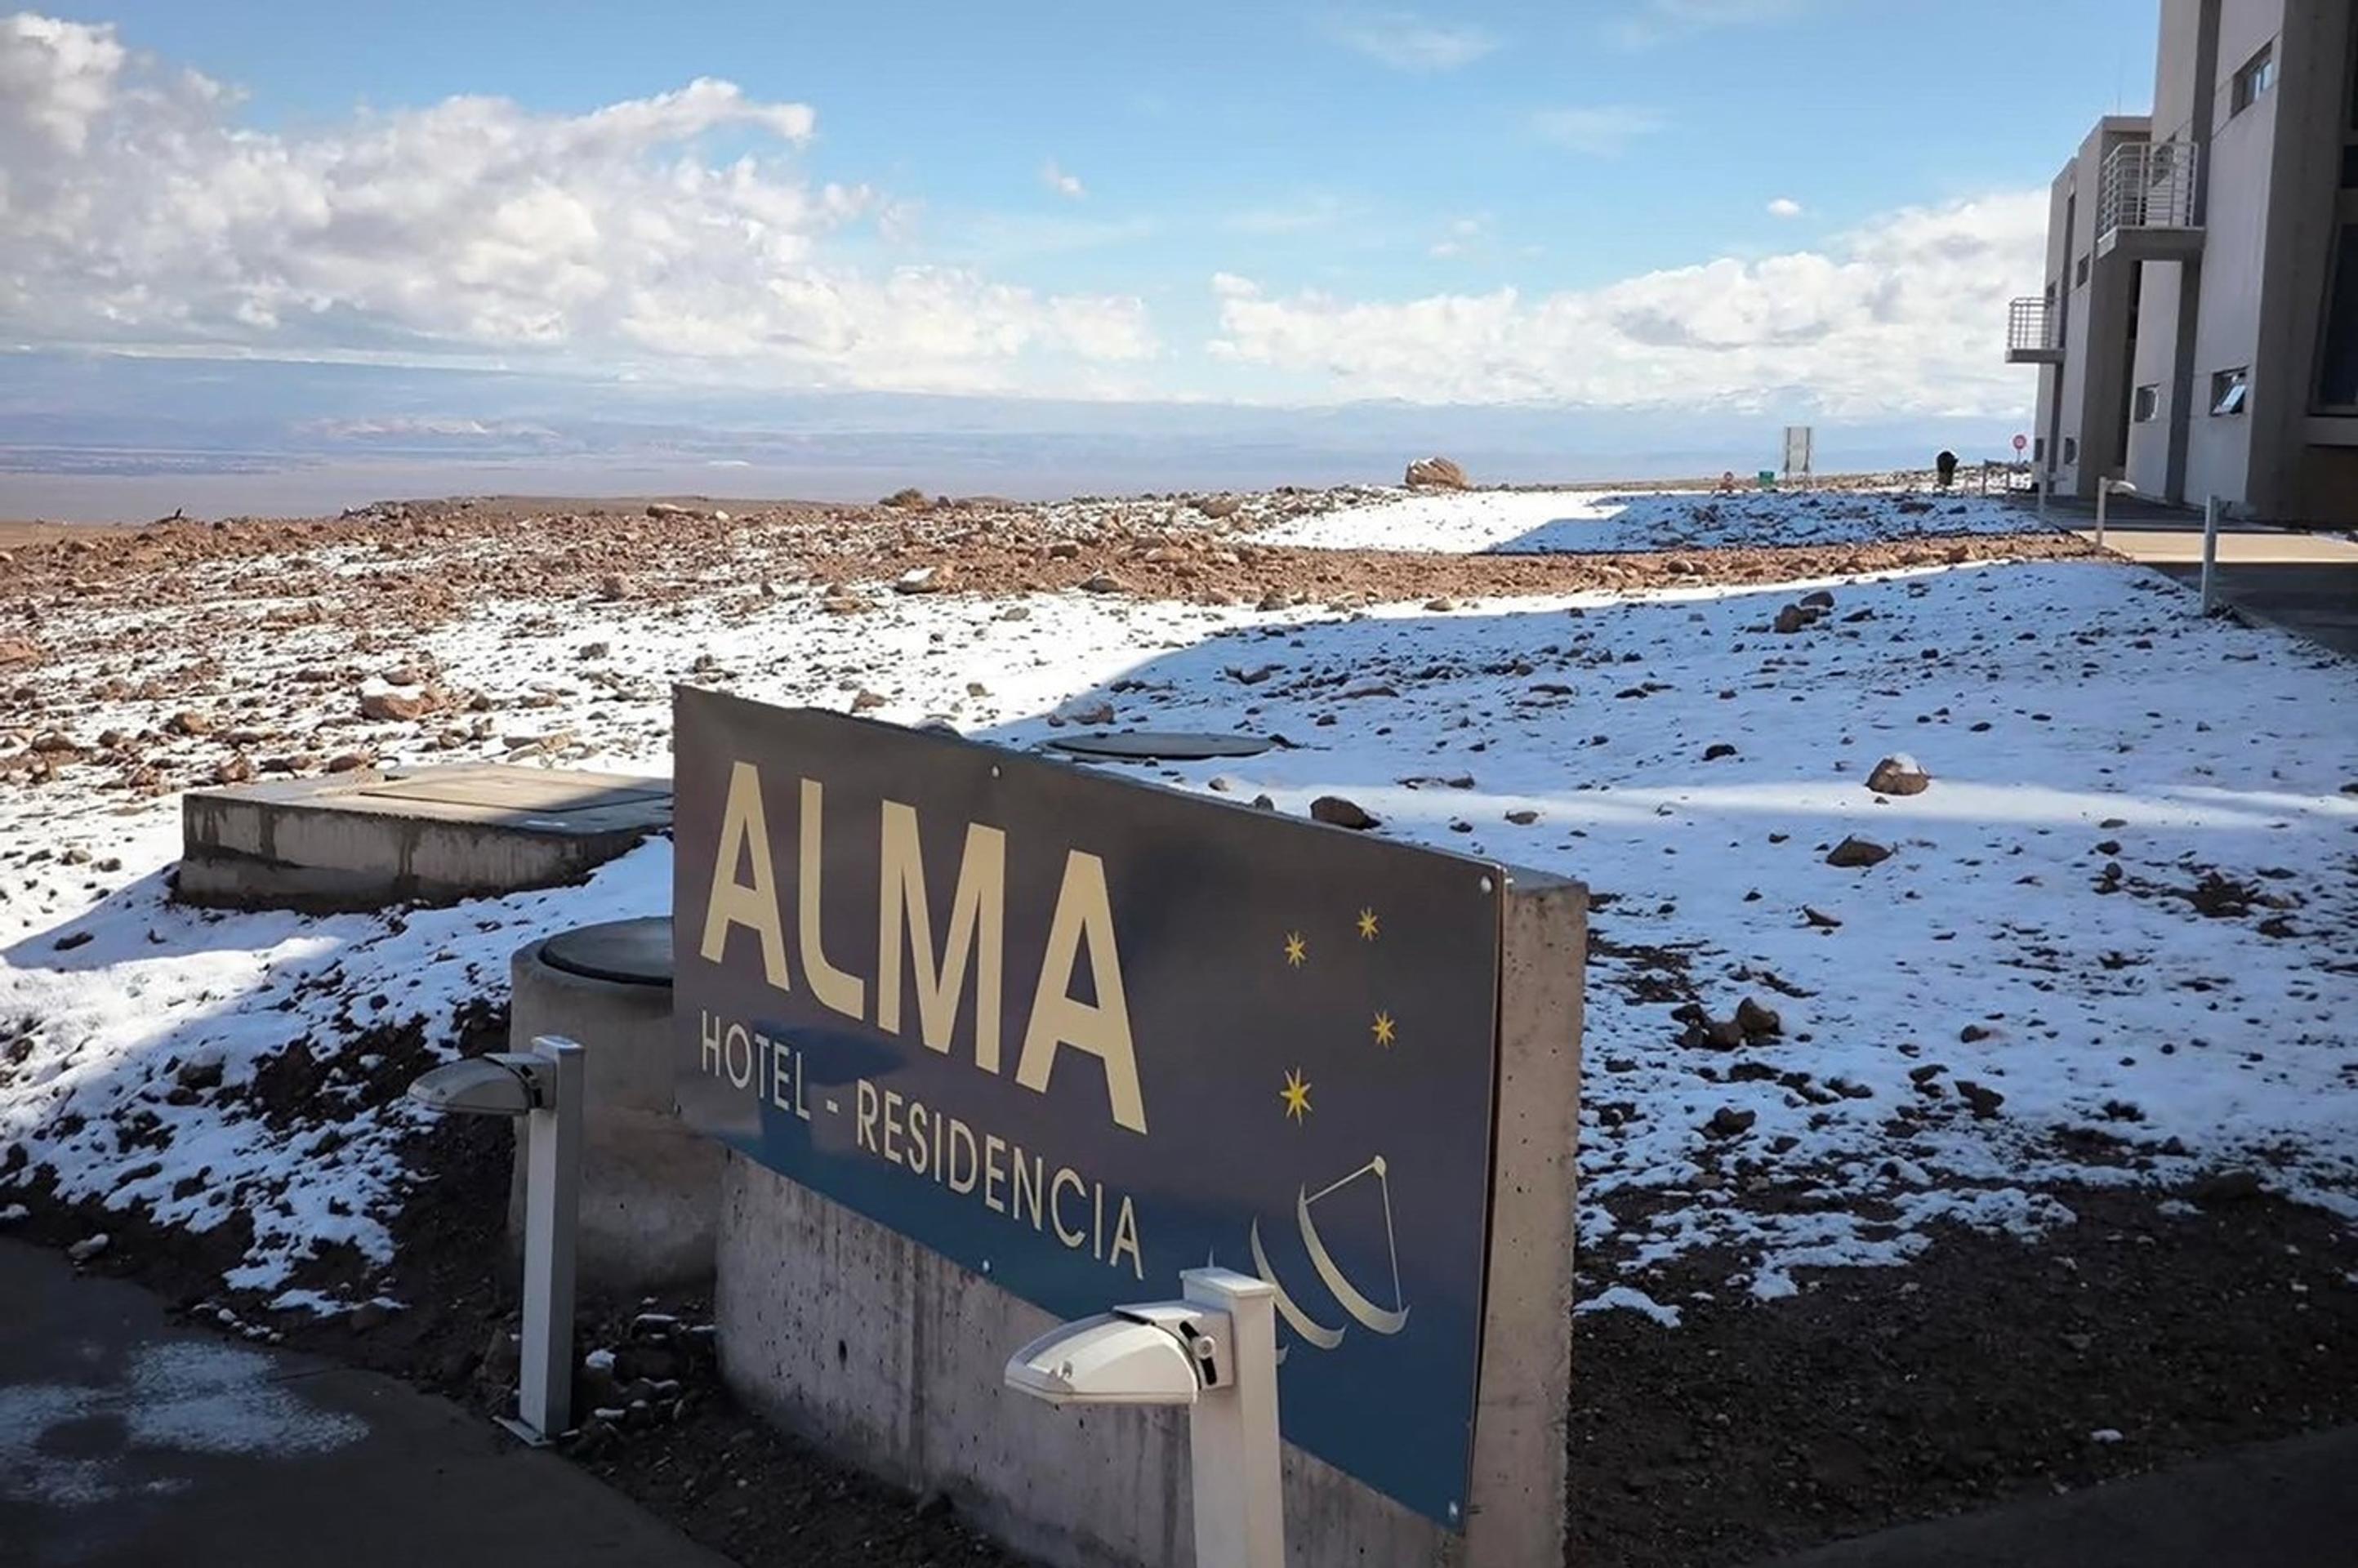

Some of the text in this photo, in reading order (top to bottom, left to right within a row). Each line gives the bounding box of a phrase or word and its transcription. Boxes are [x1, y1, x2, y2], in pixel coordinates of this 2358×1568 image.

[700, 761, 1147, 1134] ALMA
[702, 1010, 811, 1121] HOTEL
[857, 1079, 1144, 1281] RESIDENCIA
